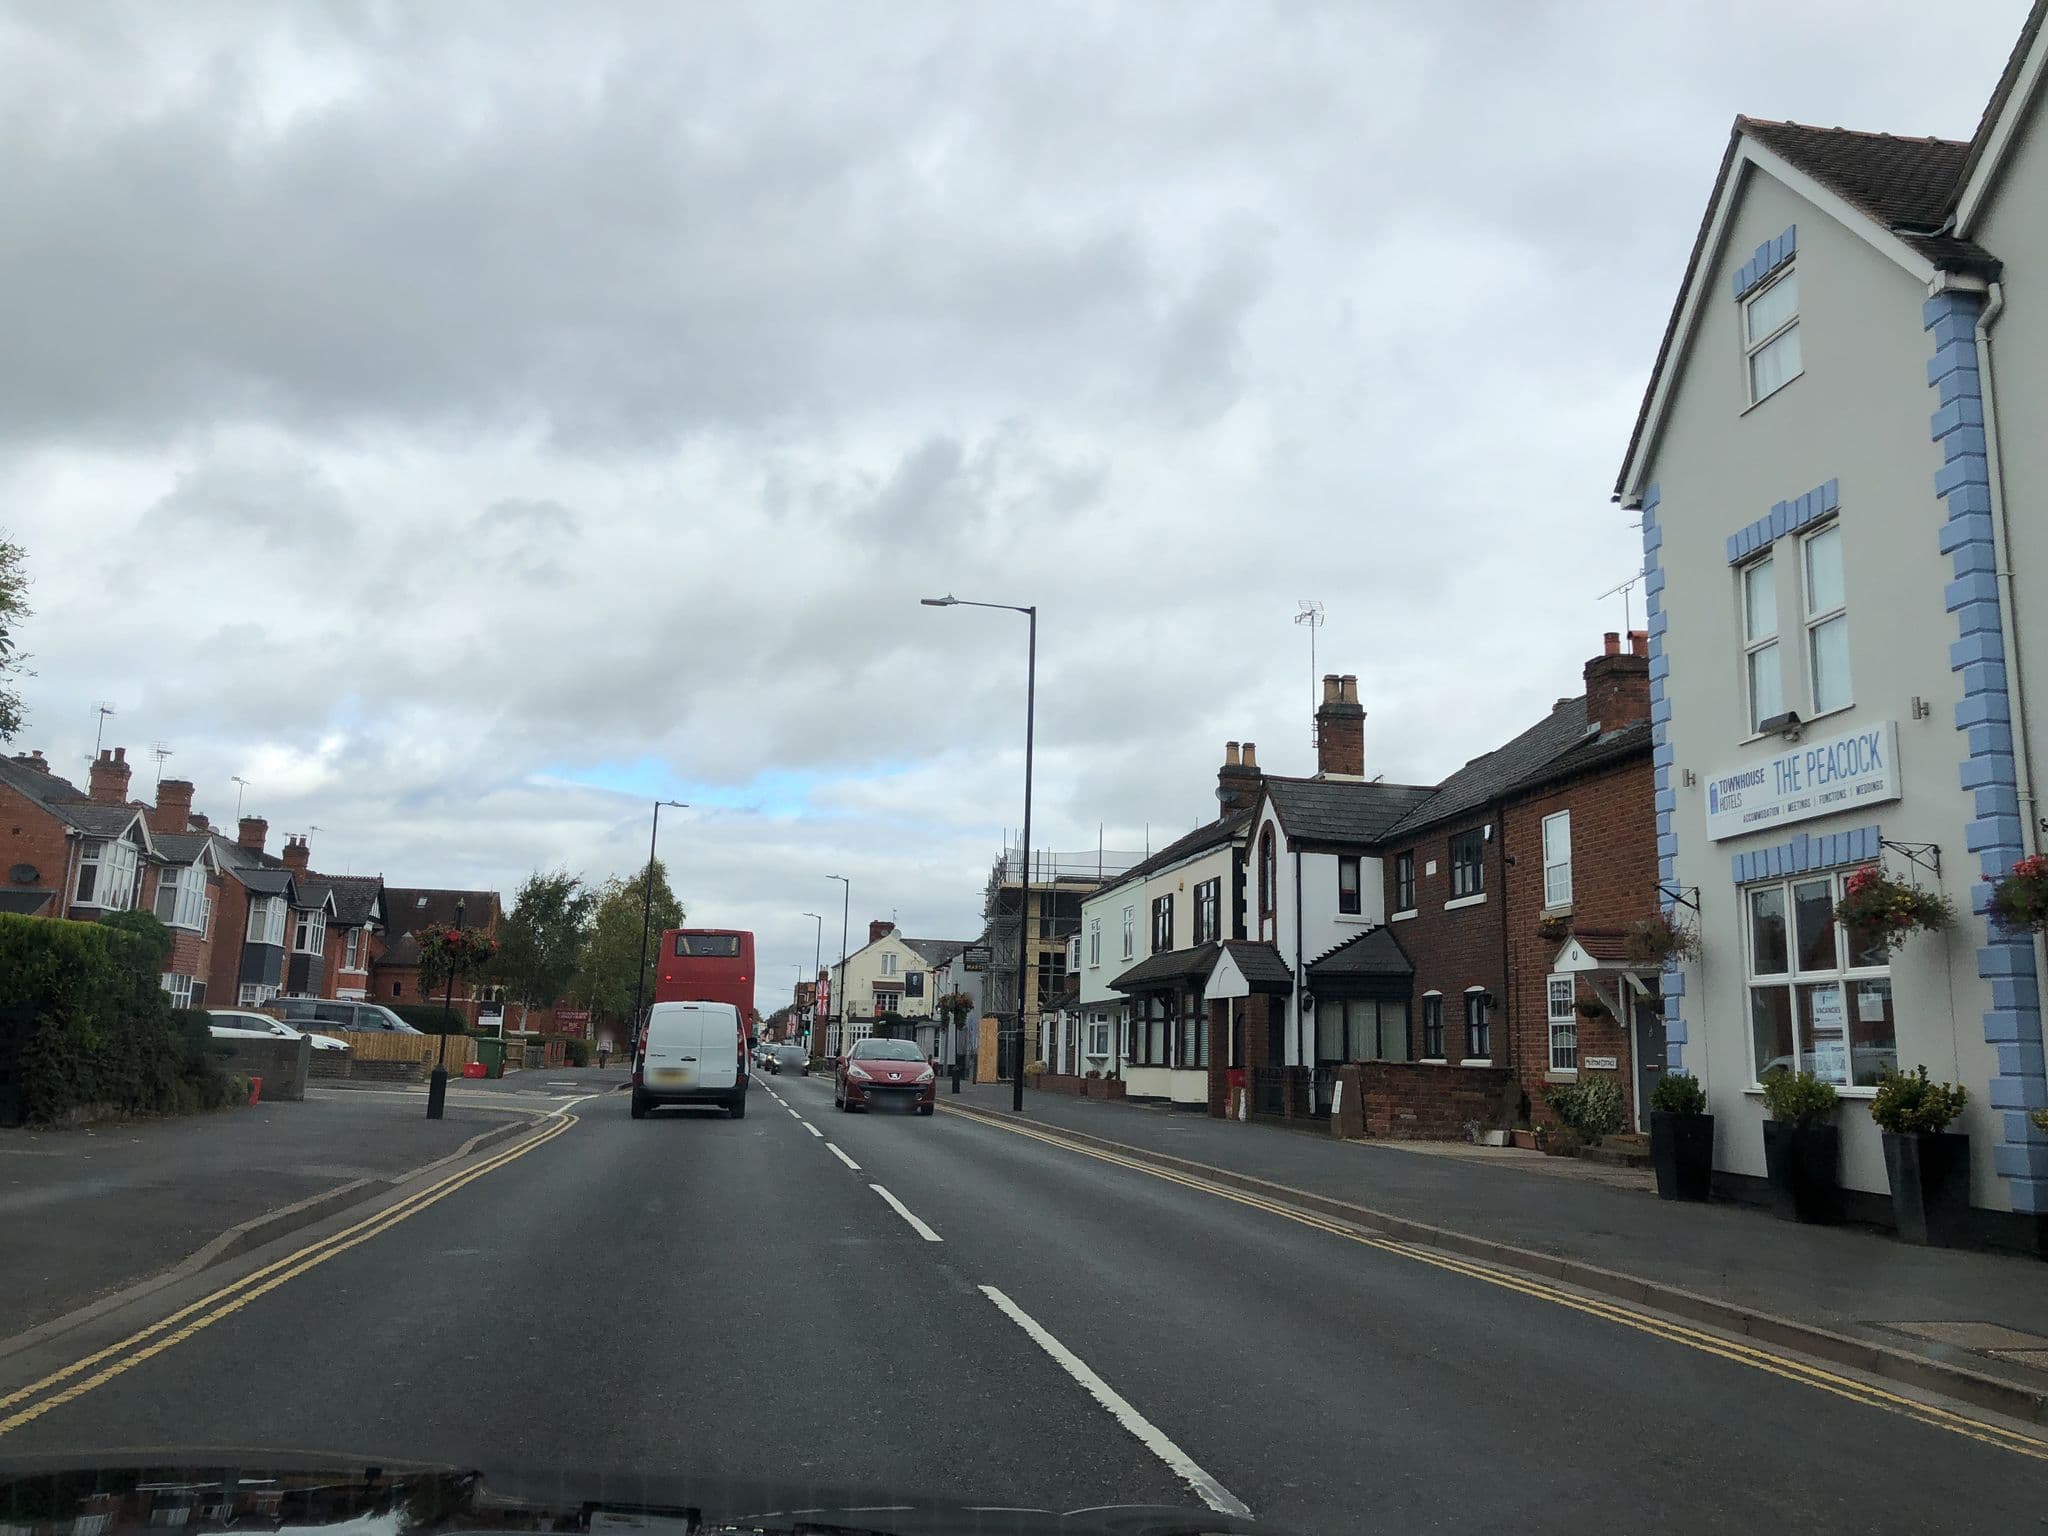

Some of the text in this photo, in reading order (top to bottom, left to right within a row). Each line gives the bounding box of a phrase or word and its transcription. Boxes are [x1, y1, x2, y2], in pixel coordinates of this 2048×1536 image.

[1773, 731, 1882, 795] THE PEACOCK
[1719, 768, 1765, 794] TOWNHOUSE
[1720, 793, 1742, 812] HOTELS
[1788, 799, 1811, 812] MEETINGS
[1819, 790, 1847, 805] FUNCTIONS
[1855, 780, 1883, 796] WEDDINGS
